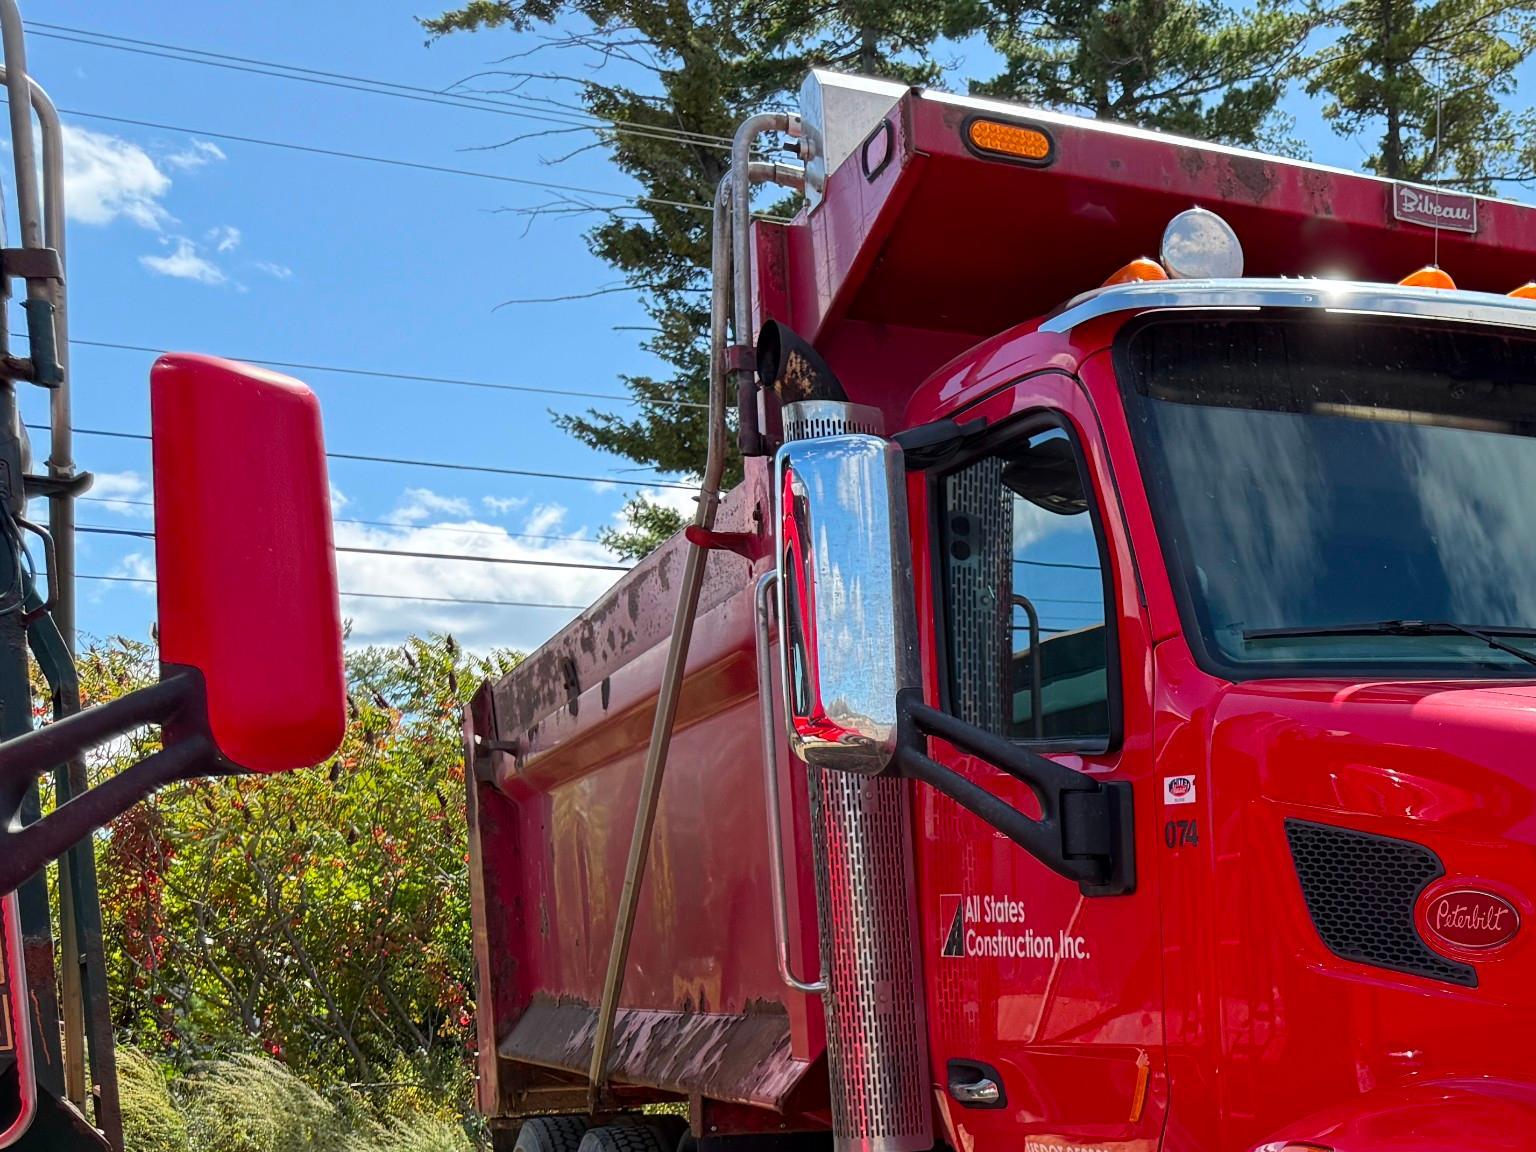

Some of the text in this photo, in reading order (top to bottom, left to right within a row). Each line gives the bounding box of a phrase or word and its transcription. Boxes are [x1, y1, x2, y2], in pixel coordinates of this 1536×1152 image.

[1400, 187, 1471, 220] Bibeau
[1165, 820, 1199, 848] 074
[965, 894, 1025, 923] All States
[1436, 899, 1509, 931] Peterbilt
[966, 928, 1091, 962] Construction, Inc.
